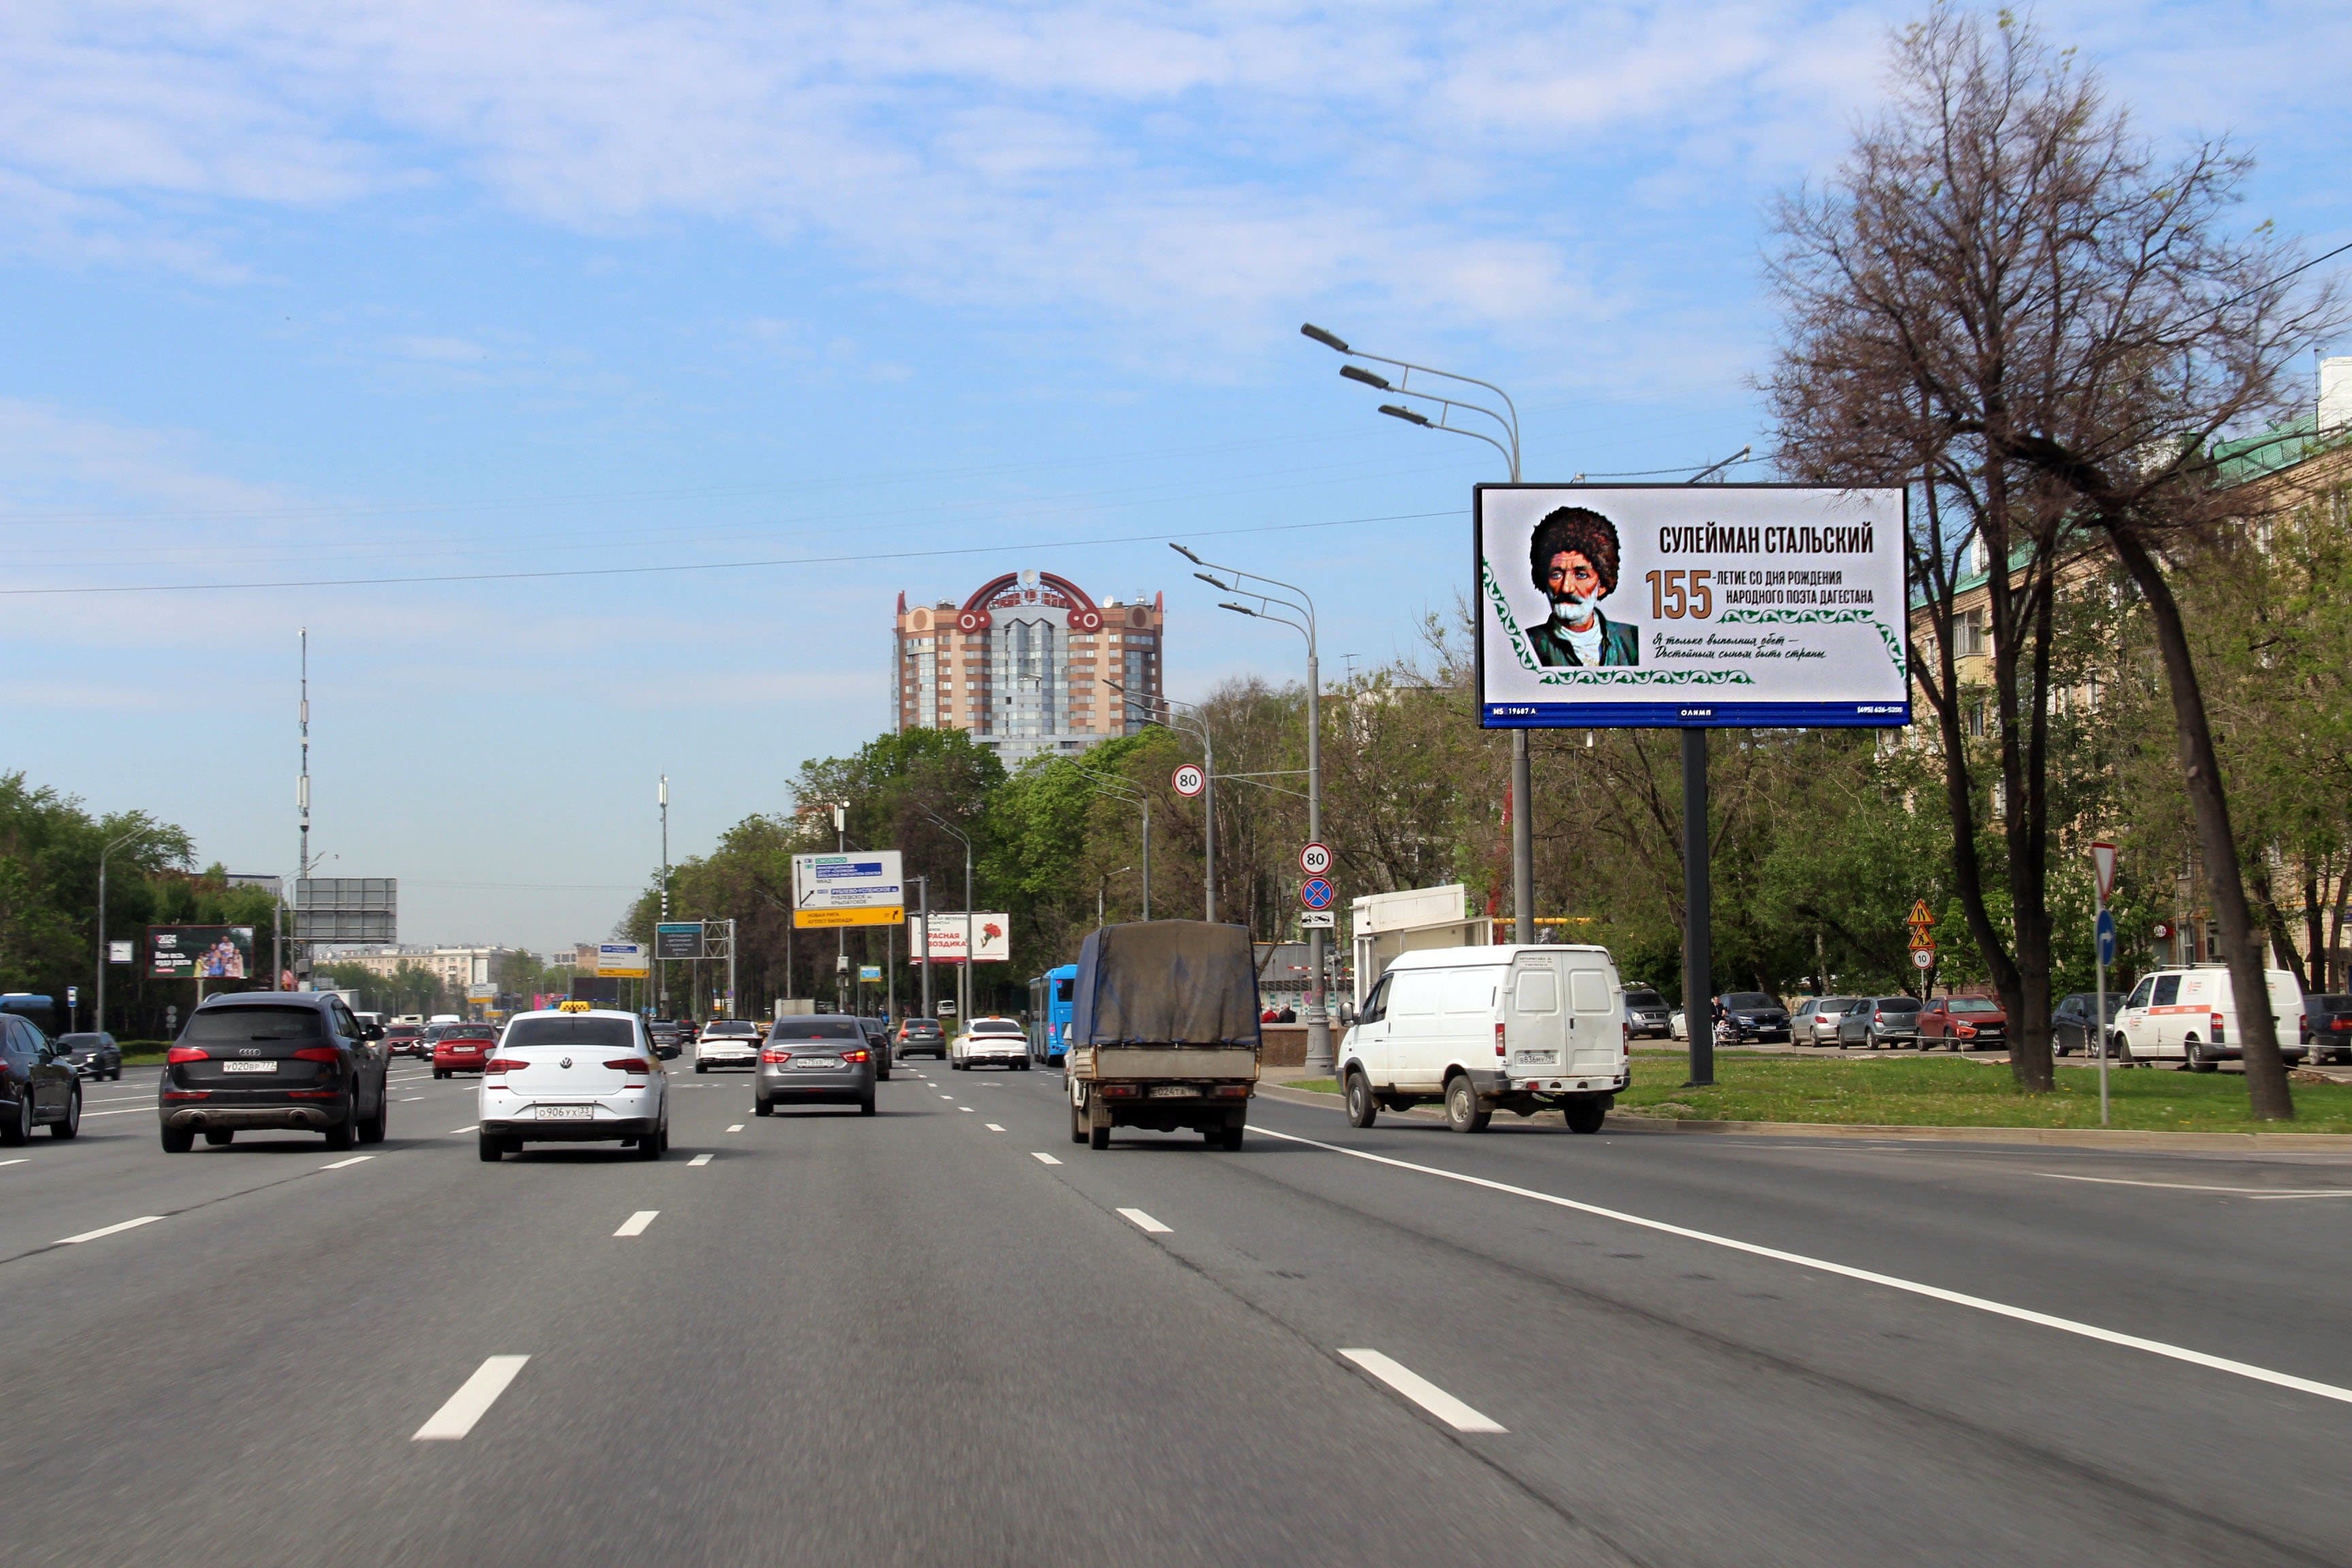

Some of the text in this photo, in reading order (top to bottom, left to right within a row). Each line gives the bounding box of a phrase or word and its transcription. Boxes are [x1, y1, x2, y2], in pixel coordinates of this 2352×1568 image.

[1659, 521, 1874, 553] СУЛЕЙМАН СТАЛЬСКИЙ
[1646, 570, 1712, 619] 155
[1749, 570, 1763, 585] СО
[1765, 570, 1785, 587] ДНЯ
[1788, 570, 1842, 587] РОЖДЕНИЯ
[1726, 589, 1874, 605] НАРОДНОГО ПОЭТА ДАГЕСТАНА
[1652, 632, 1663, 645] Я
[1665, 636, 1703, 645] только
[1760, 633, 1784, 645] обет
[1654, 645, 1827, 662] Достойным сыном быть страны
[1179, 774, 1197, 787] 80
[1307, 853, 1324, 865] 80
[1918, 955, 1927, 963] 10
[539, 1107, 578, 1117] О906УХ
